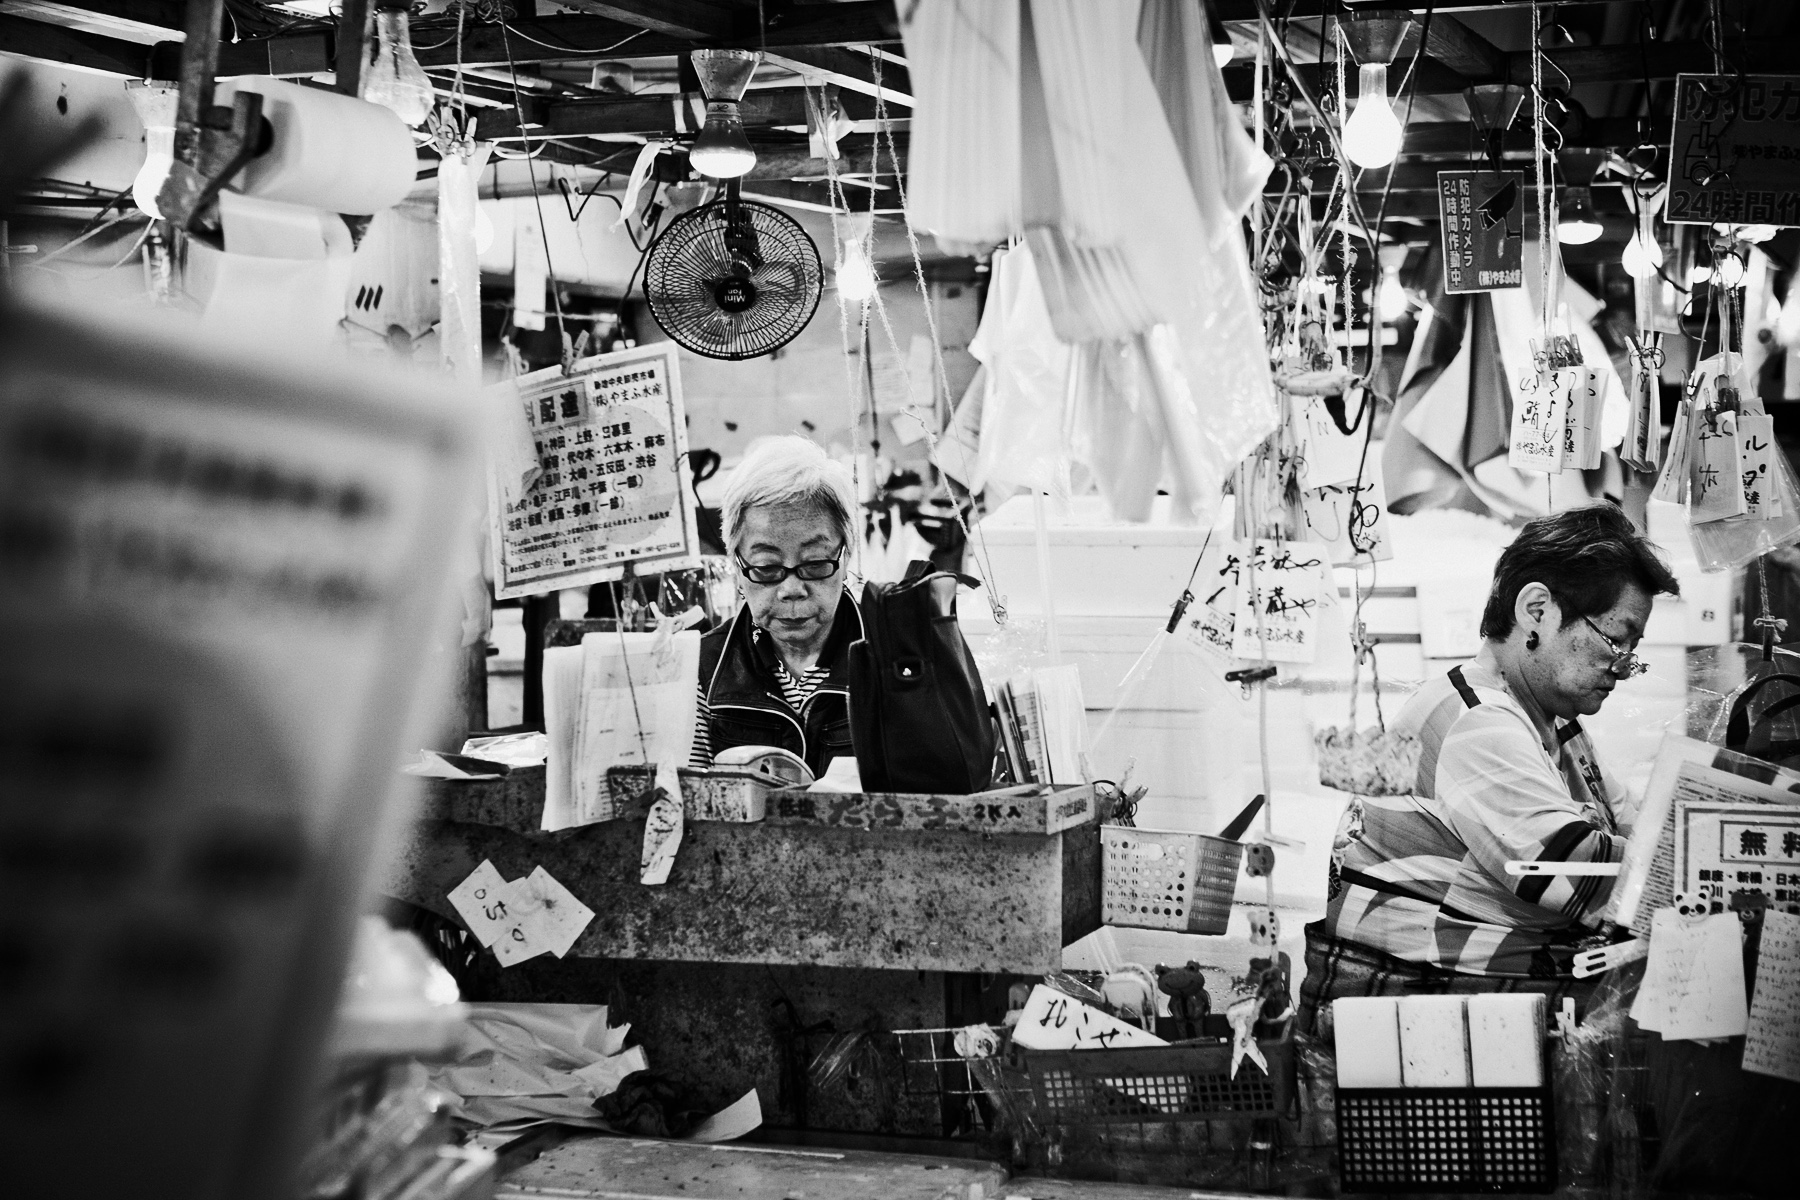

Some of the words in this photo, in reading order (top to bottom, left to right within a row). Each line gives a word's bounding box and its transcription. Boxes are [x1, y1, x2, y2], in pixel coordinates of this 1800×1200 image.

[1443, 180, 1461, 286] 24時間作動中
[1459, 178, 1473, 267] 防犯カメラ
[724, 294, 746, 303] Mini
